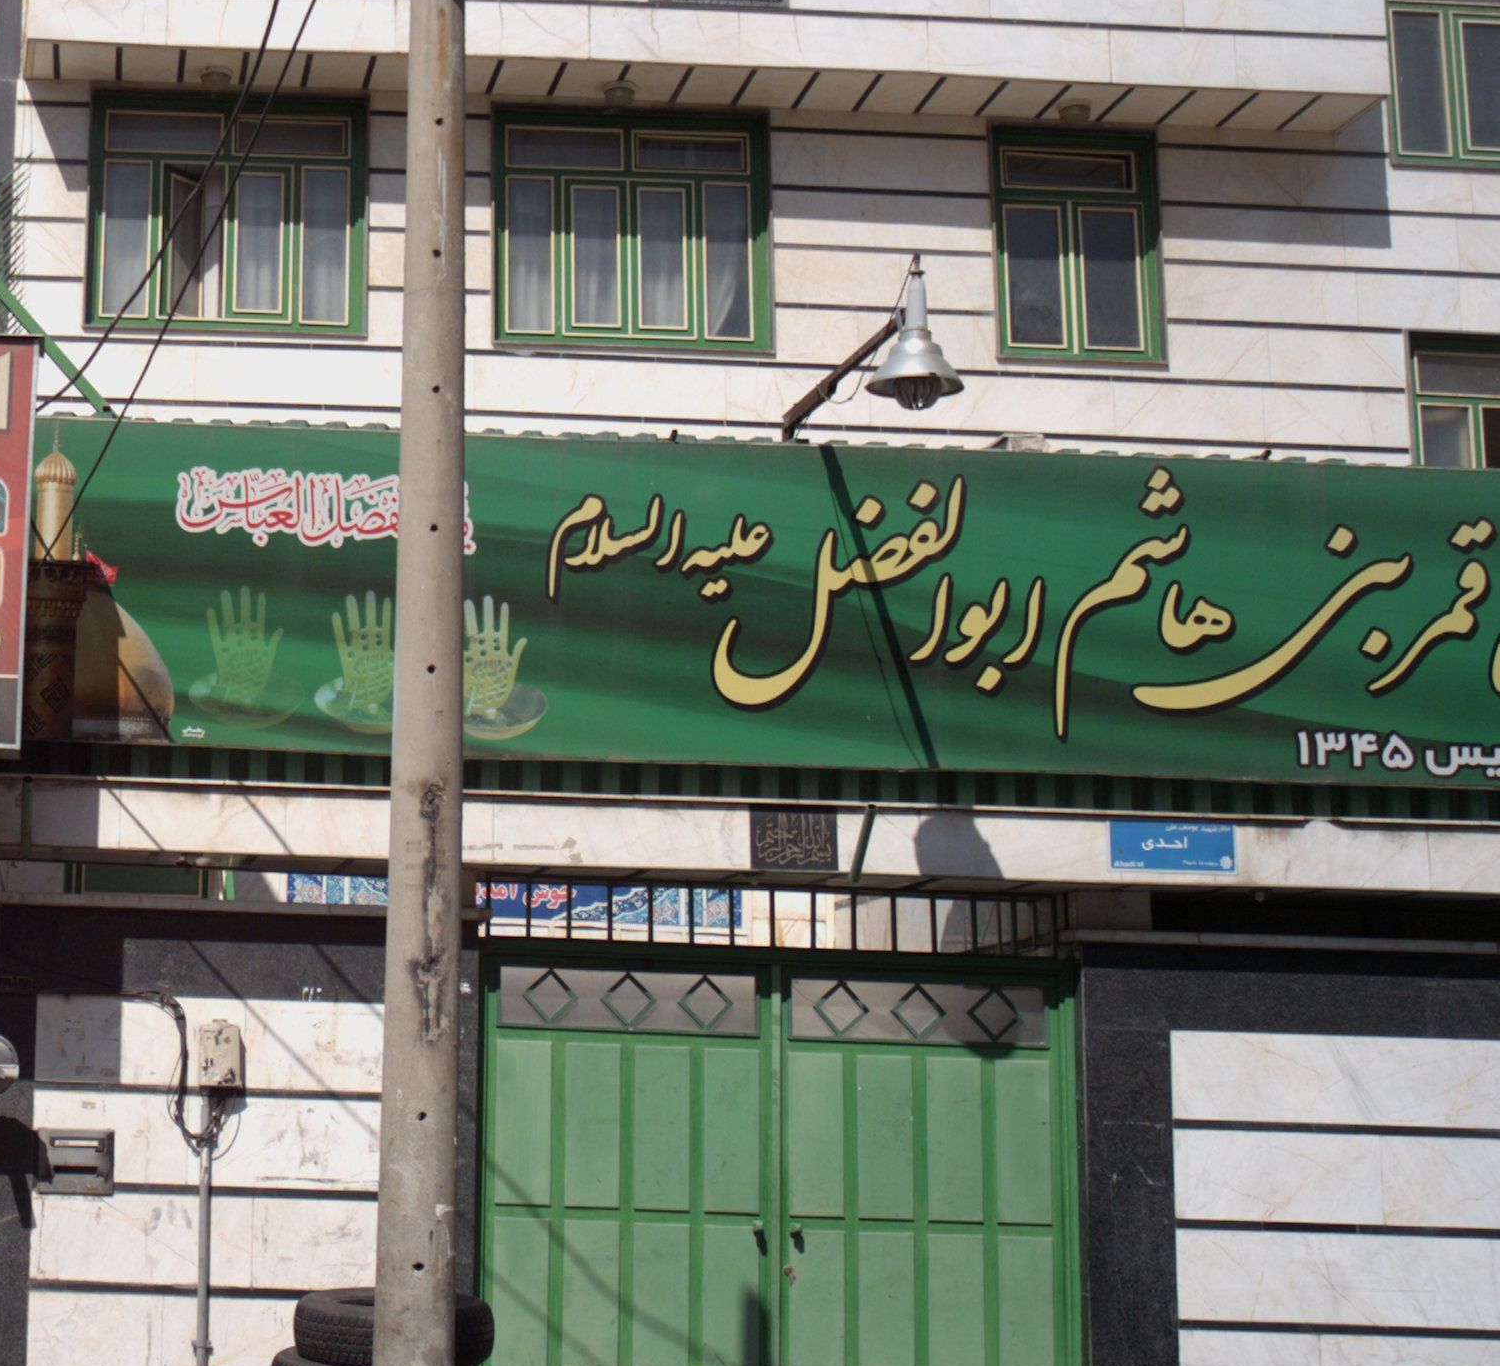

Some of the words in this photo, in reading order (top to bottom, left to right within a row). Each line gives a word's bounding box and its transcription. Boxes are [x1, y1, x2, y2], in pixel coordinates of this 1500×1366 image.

[546, 494, 684, 597] السلام
[680, 515, 771, 600] علیه
[1054, 467, 1234, 739] هاشم
[1130, 526, 1412, 712] بنی
[1368, 519, 1492, 693] قمر
[1297, 731, 1414, 770] ۱۳۴۵
[1141, 836, 1188, 851] احدی
